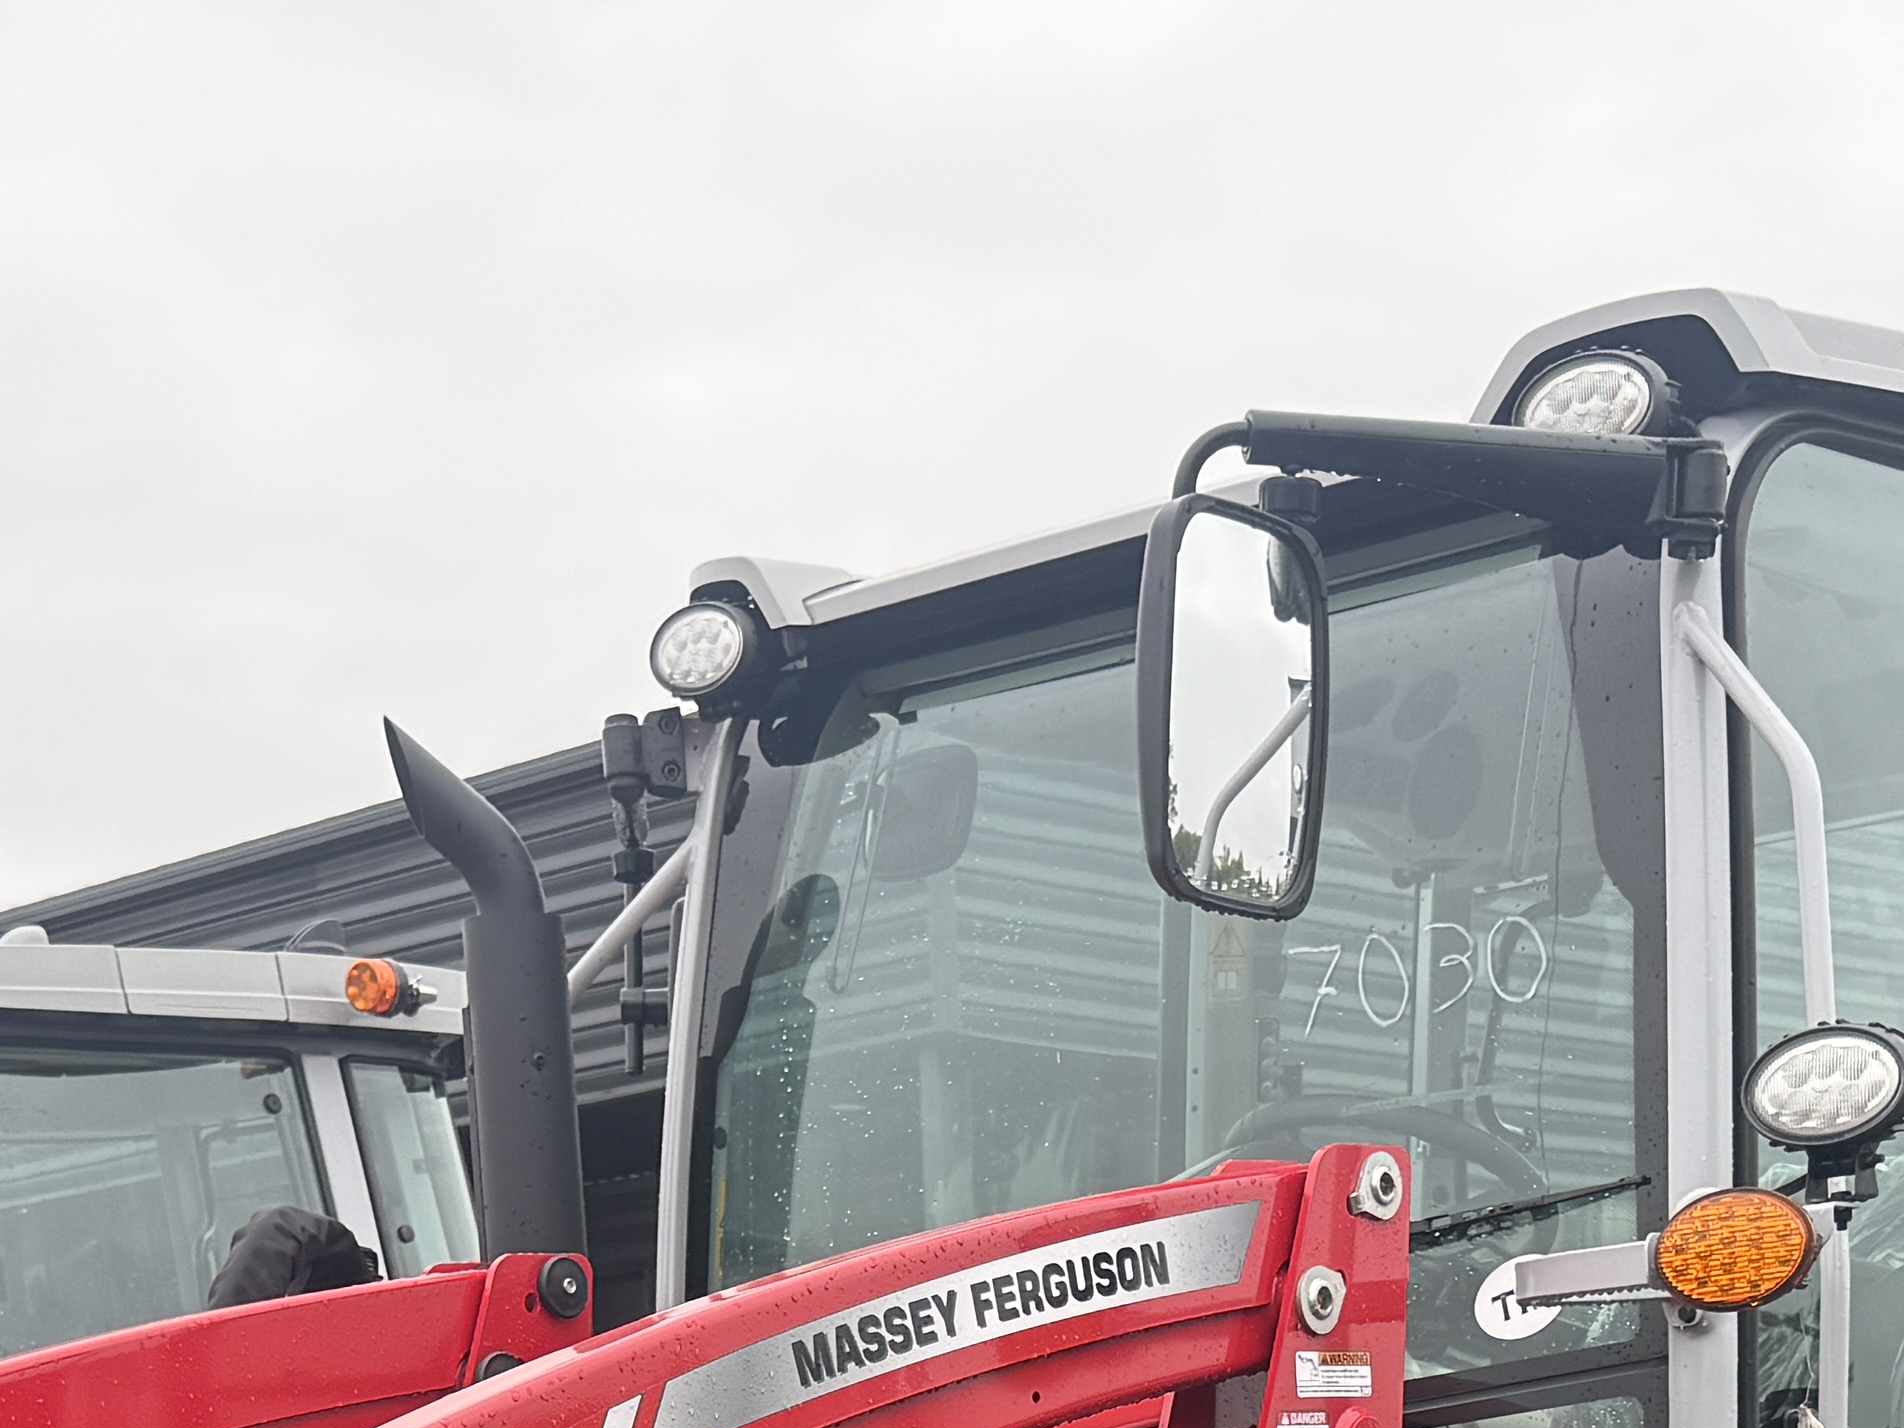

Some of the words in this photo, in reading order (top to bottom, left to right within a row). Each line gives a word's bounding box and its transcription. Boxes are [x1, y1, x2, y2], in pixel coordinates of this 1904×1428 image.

[1287, 915, 1549, 1038] 7030
[791, 1290, 962, 1390] MASSEY
[972, 1240, 1170, 1334] FERGUSON
[1289, 1412, 1327, 1425] DANGER
